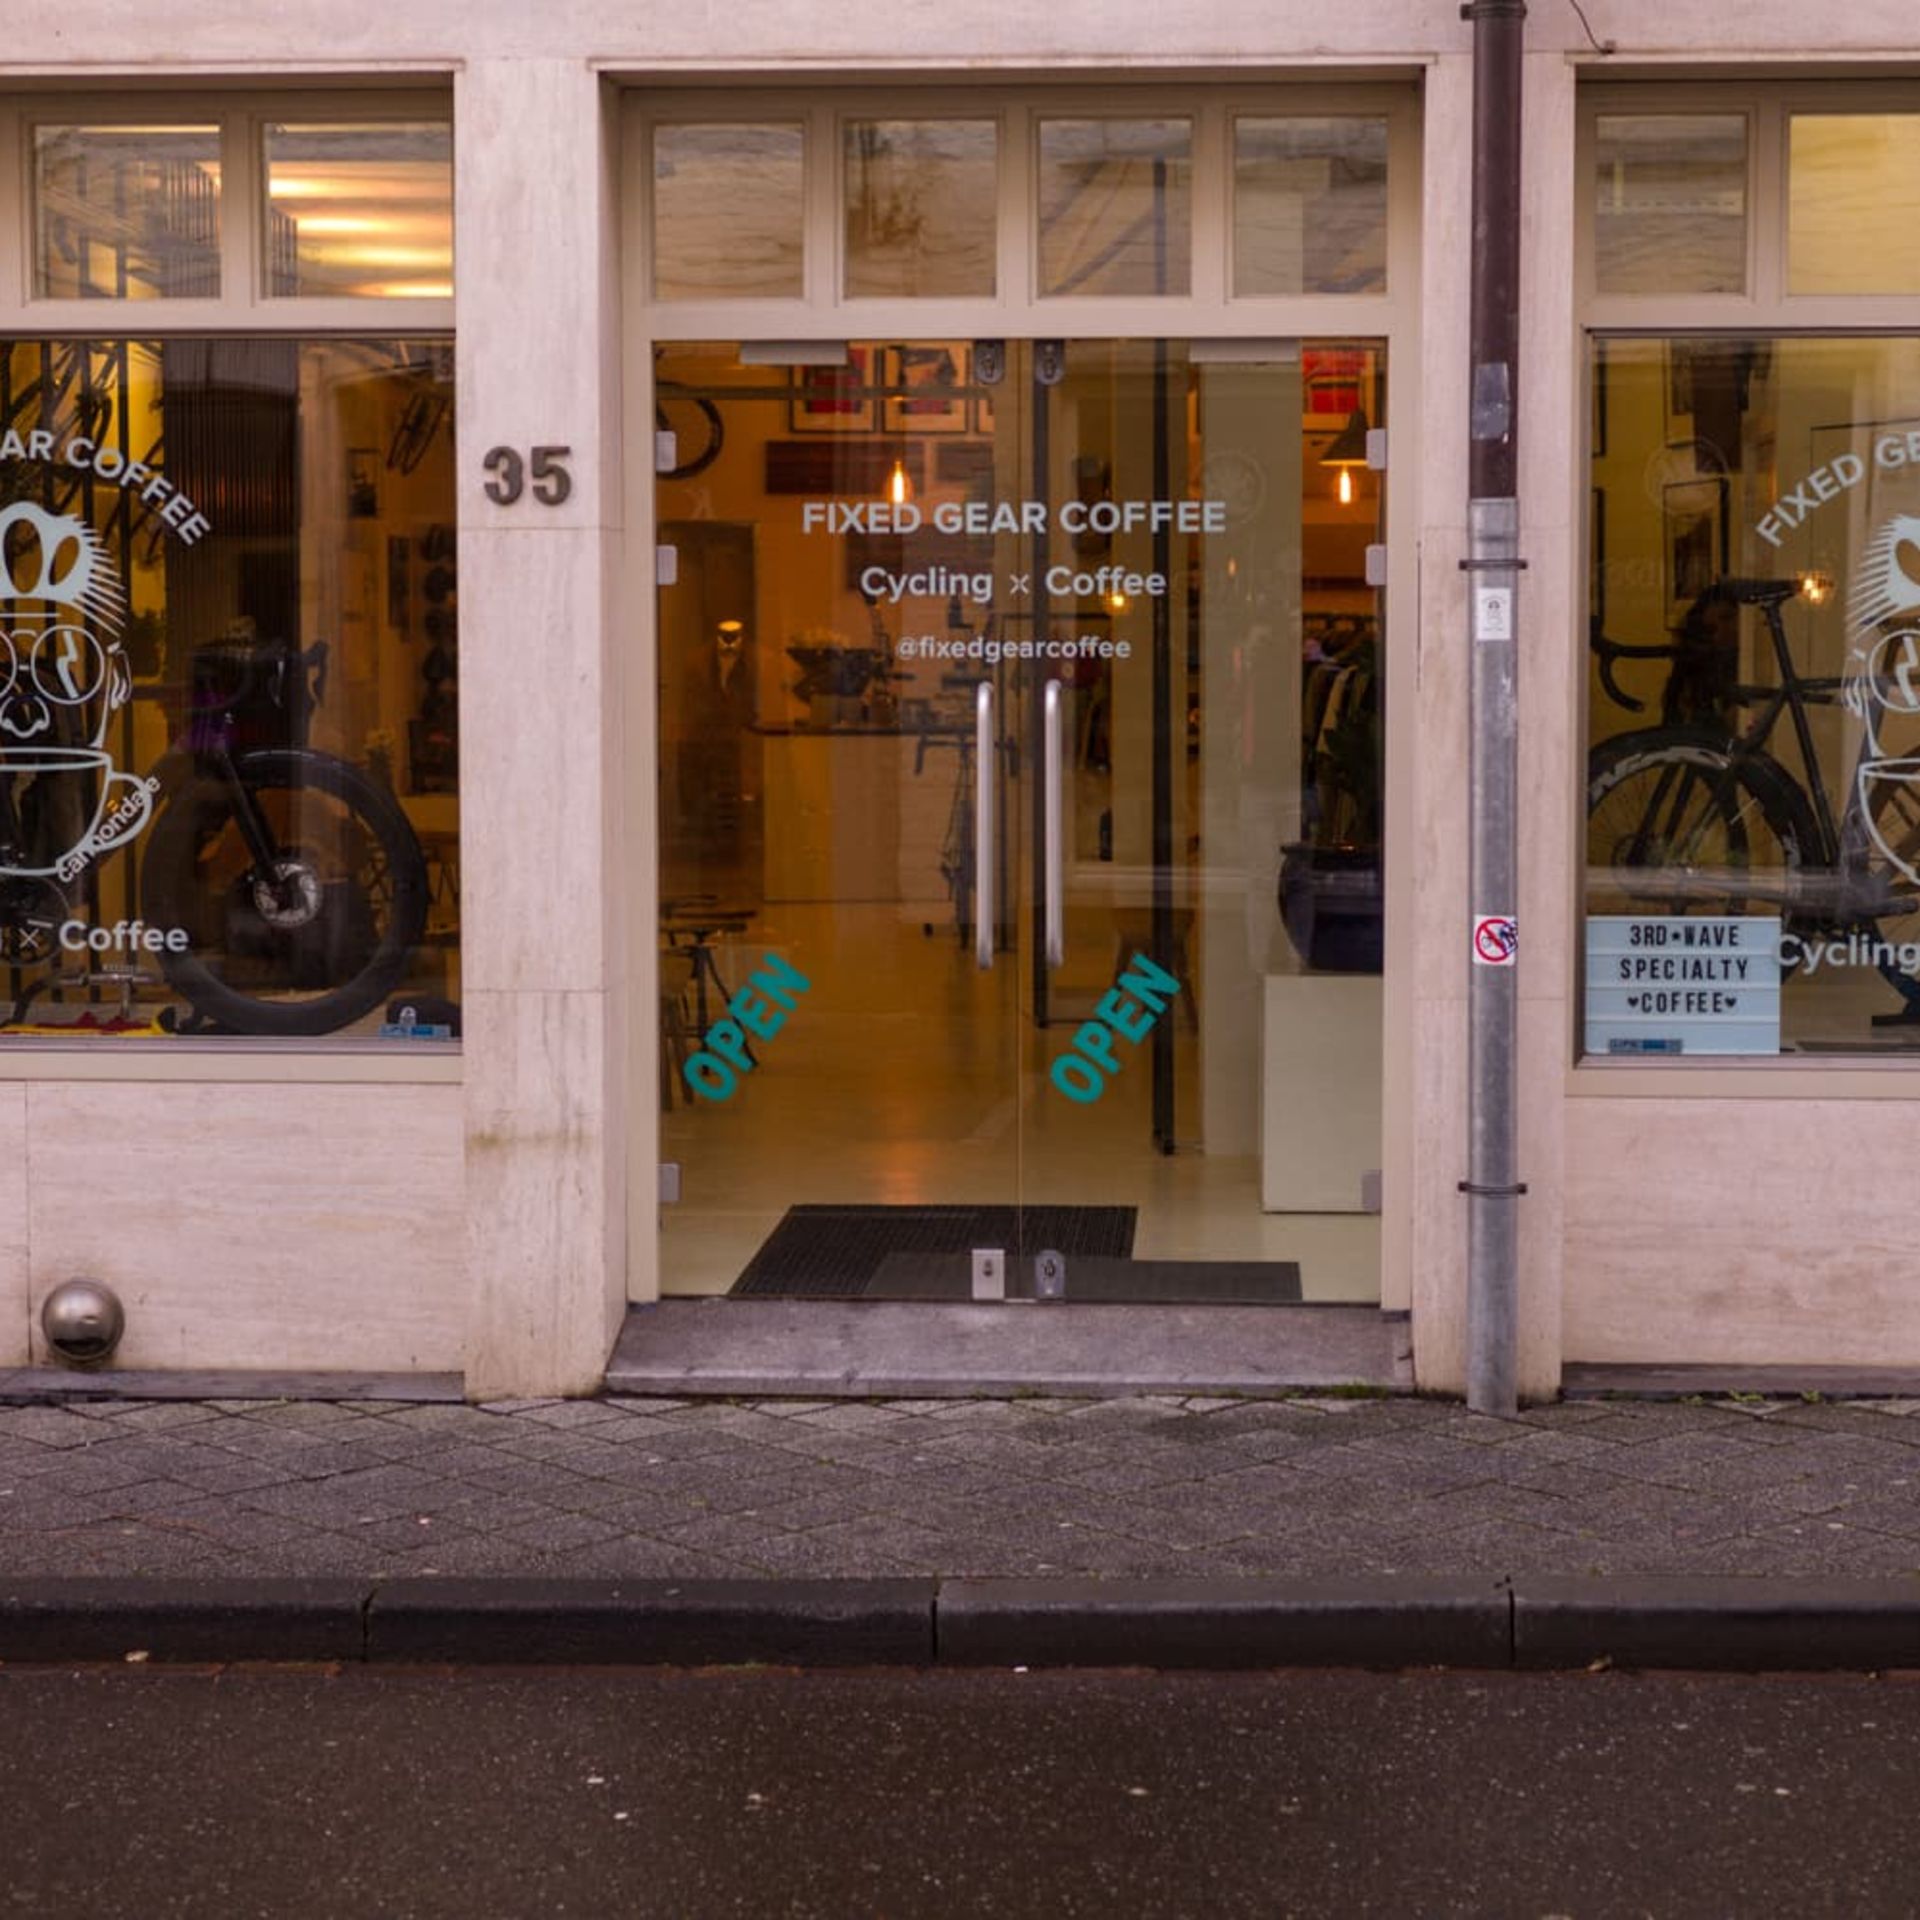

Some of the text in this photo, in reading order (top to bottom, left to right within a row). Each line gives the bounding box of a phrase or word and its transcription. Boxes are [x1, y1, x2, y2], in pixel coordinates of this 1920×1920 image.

[66, 437, 211, 546] COFFEE
[484, 445, 571, 506] 35
[803, 502, 1226, 534] FIXED GEAR COFFEE
[1755, 453, 1864, 547] FIXED
[861, 566, 993, 603] Cycling
[1045, 566, 1167, 596] Coffee
[898, 636, 1131, 662] @fixedgearcoffee
[59, 919, 189, 951] Coffee
[1630, 925, 1739, 946] 3RD WAVE
[1620, 958, 1748, 980] SPECIALTY
[1778, 934, 1920, 974] Cycling
[1641, 992, 1723, 1013] COFFEE
[682, 952, 811, 1103] OPEN
[1050, 952, 1181, 1104] OPEN
